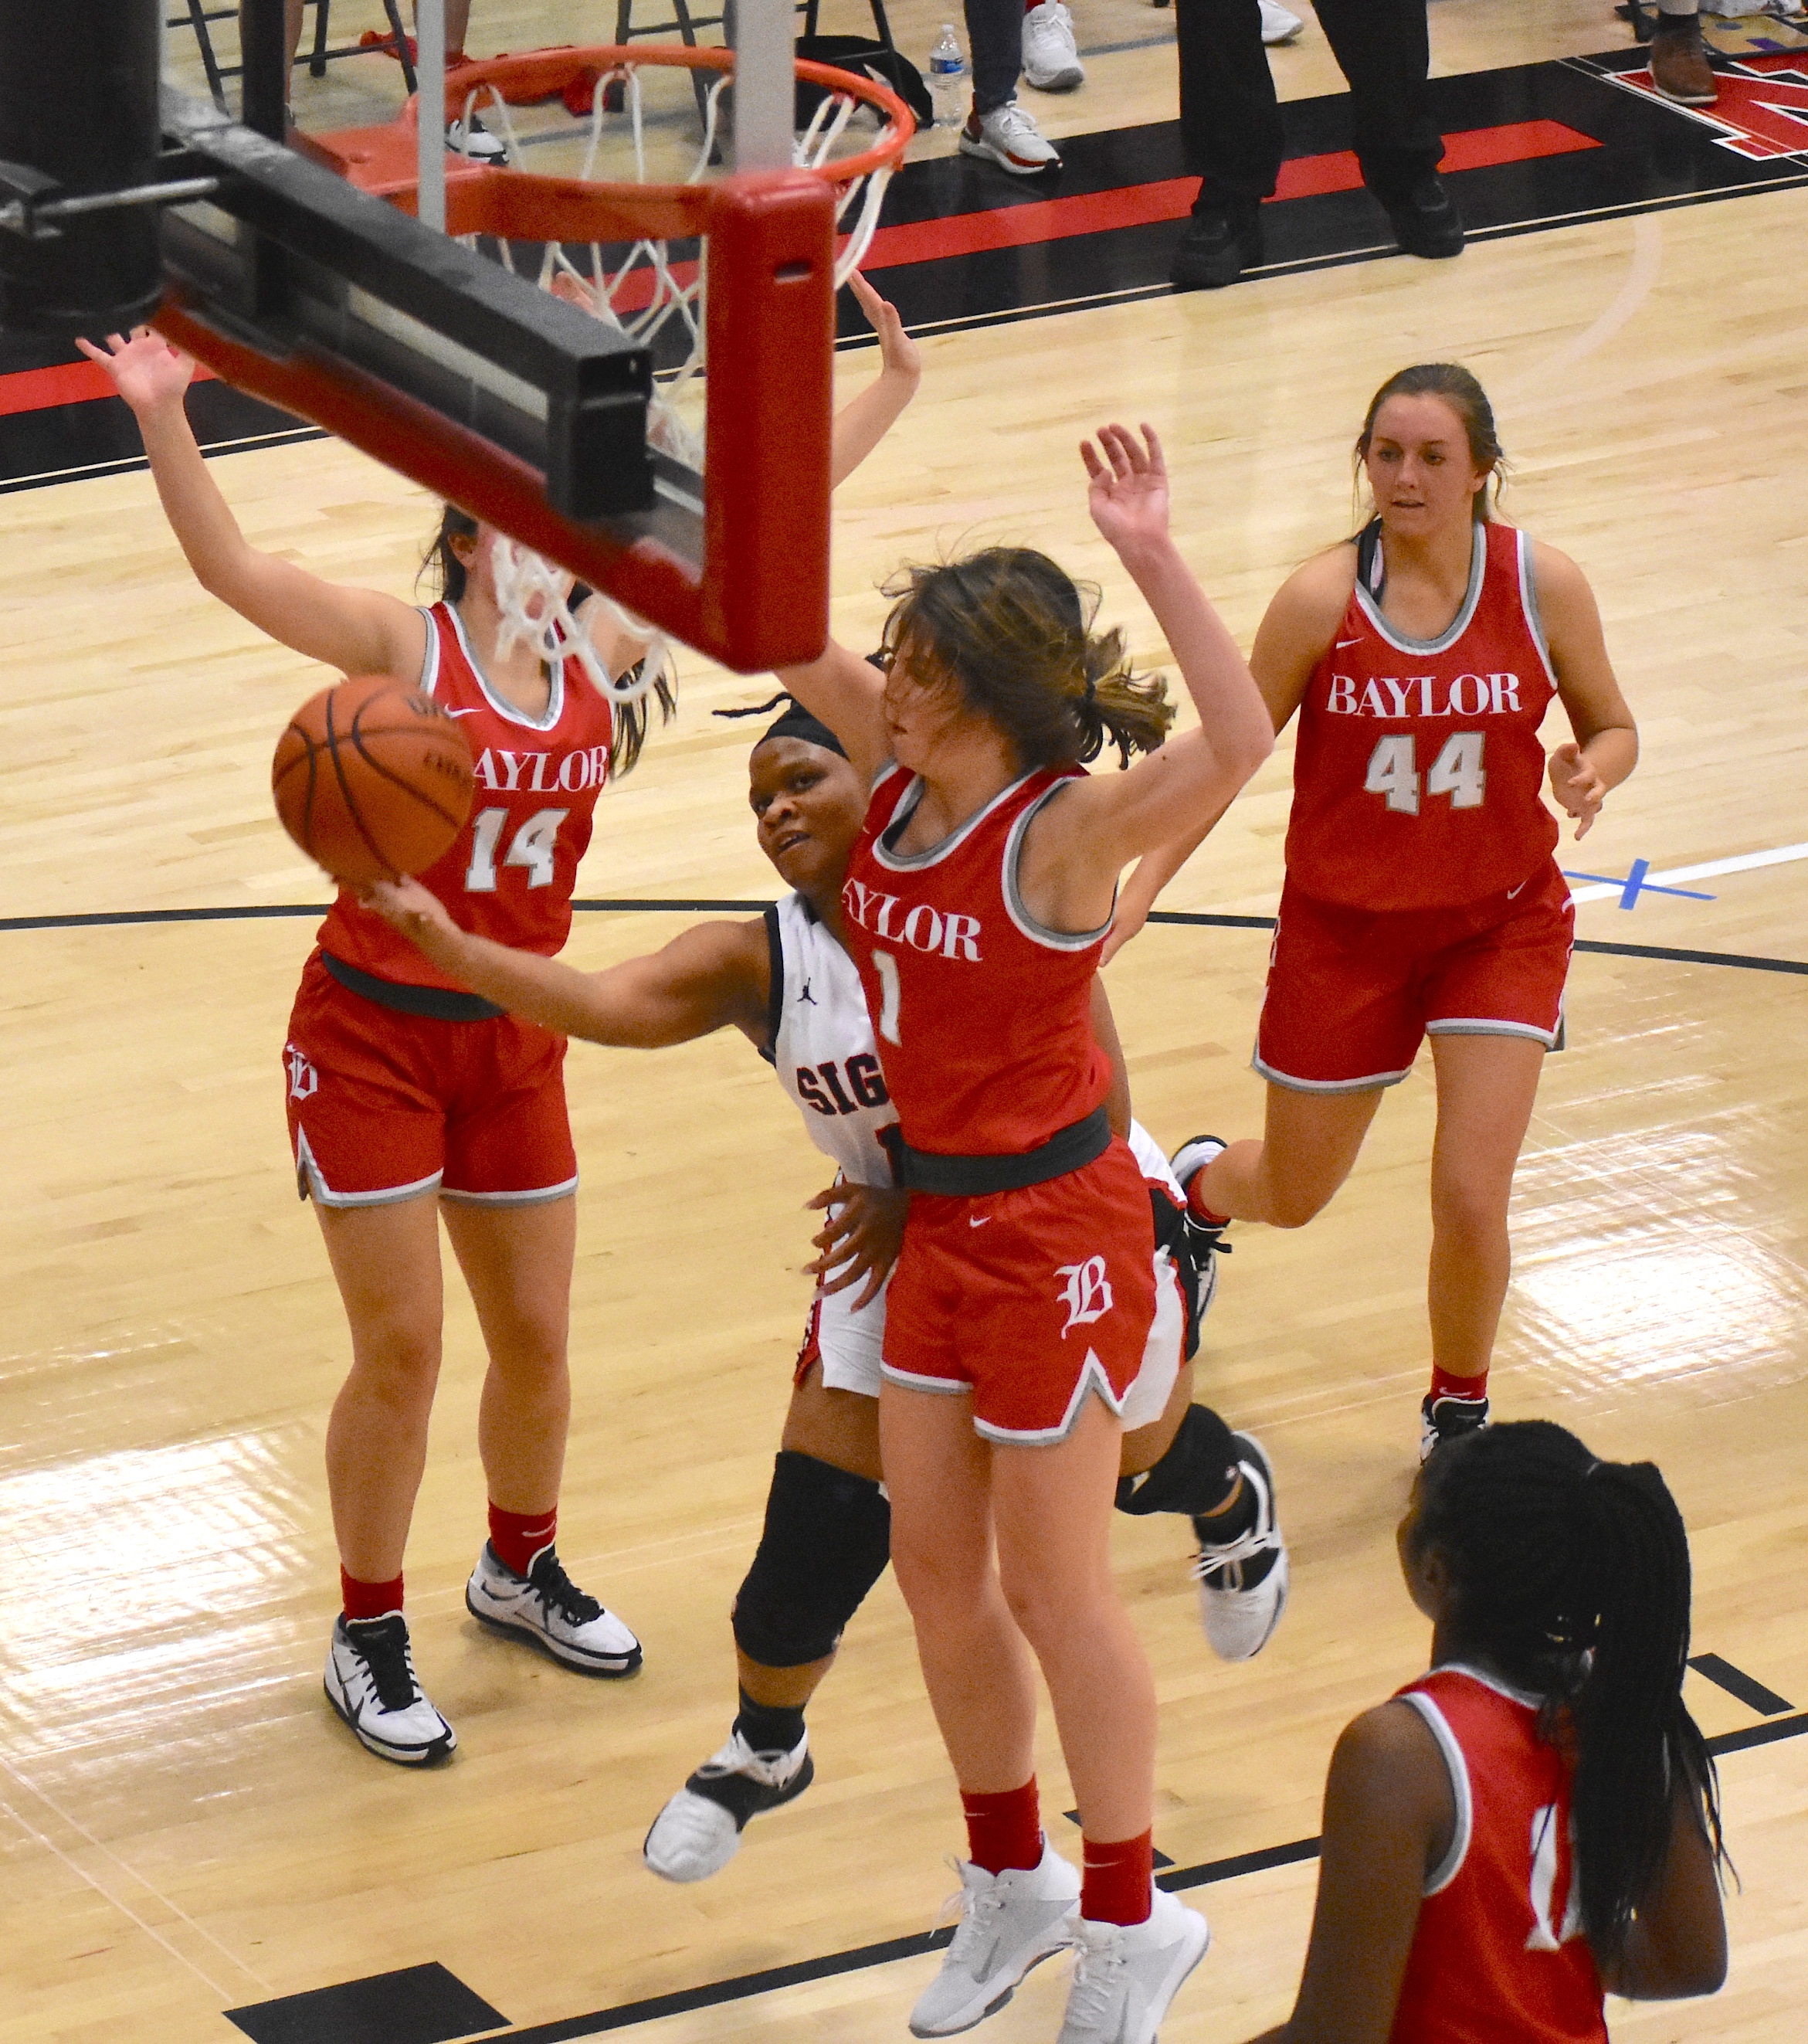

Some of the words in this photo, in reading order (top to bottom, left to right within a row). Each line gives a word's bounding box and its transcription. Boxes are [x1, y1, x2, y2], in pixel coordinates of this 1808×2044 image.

[1325, 672, 1523, 718] BAYLOR
[1363, 731, 1487, 817] 44
[464, 806, 570, 892] 14
[1053, 1255, 1114, 1340] B
